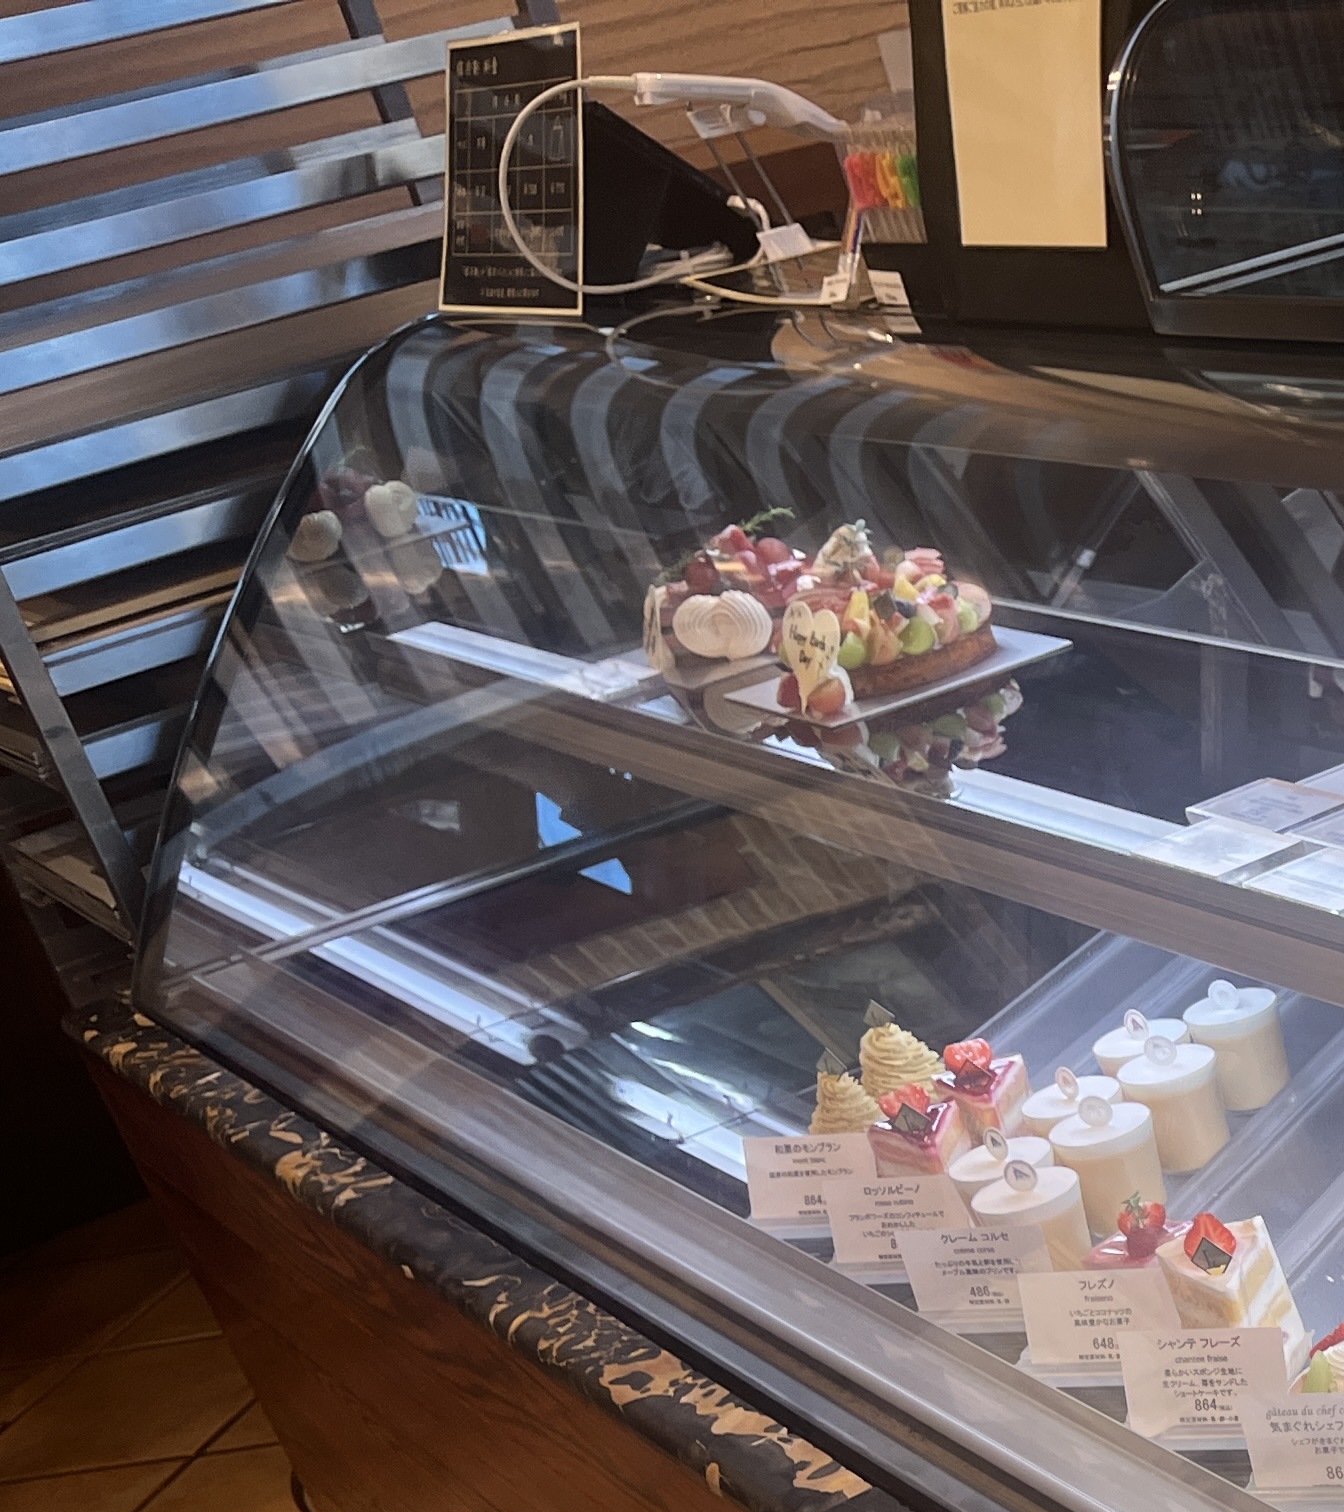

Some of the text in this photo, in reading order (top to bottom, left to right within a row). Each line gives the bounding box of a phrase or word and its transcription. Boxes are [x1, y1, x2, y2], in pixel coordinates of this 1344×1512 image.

[1078, 1278, 1115, 1291] フレズノ
[1092, 1337, 1114, 1350] 648
[1194, 1398, 1217, 1411] 864
